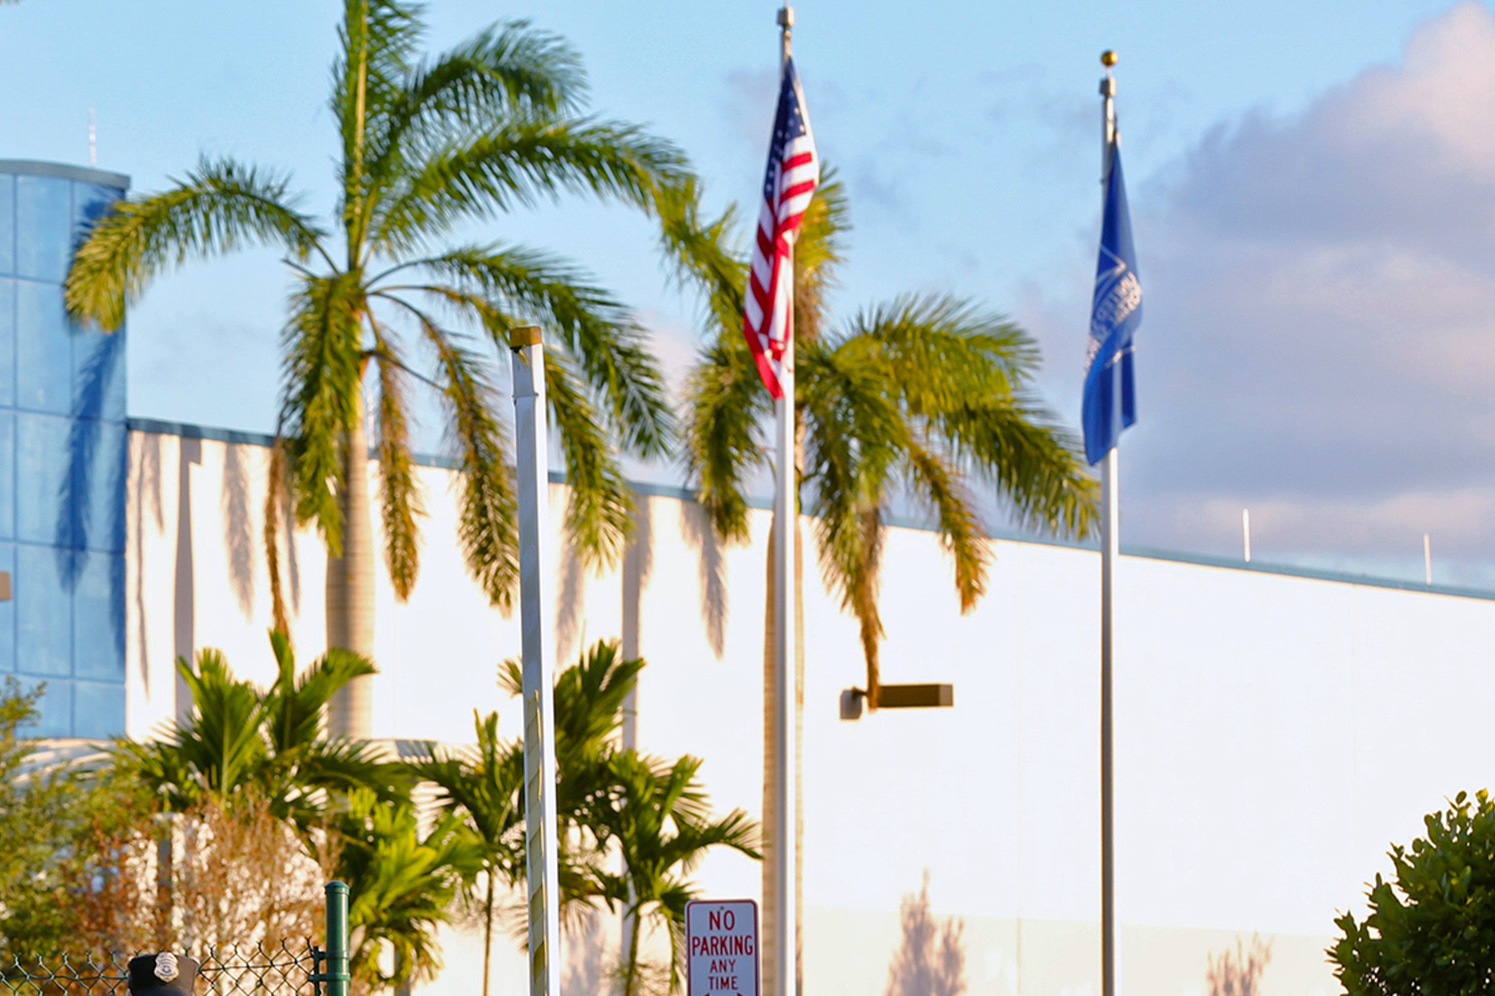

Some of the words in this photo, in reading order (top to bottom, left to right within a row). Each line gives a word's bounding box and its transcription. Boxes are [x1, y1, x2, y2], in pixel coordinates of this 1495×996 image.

[709, 909, 736, 931] NO
[691, 935, 753, 956] PARKING
[710, 959, 736, 973] ANY
[709, 976, 738, 990] TIME
